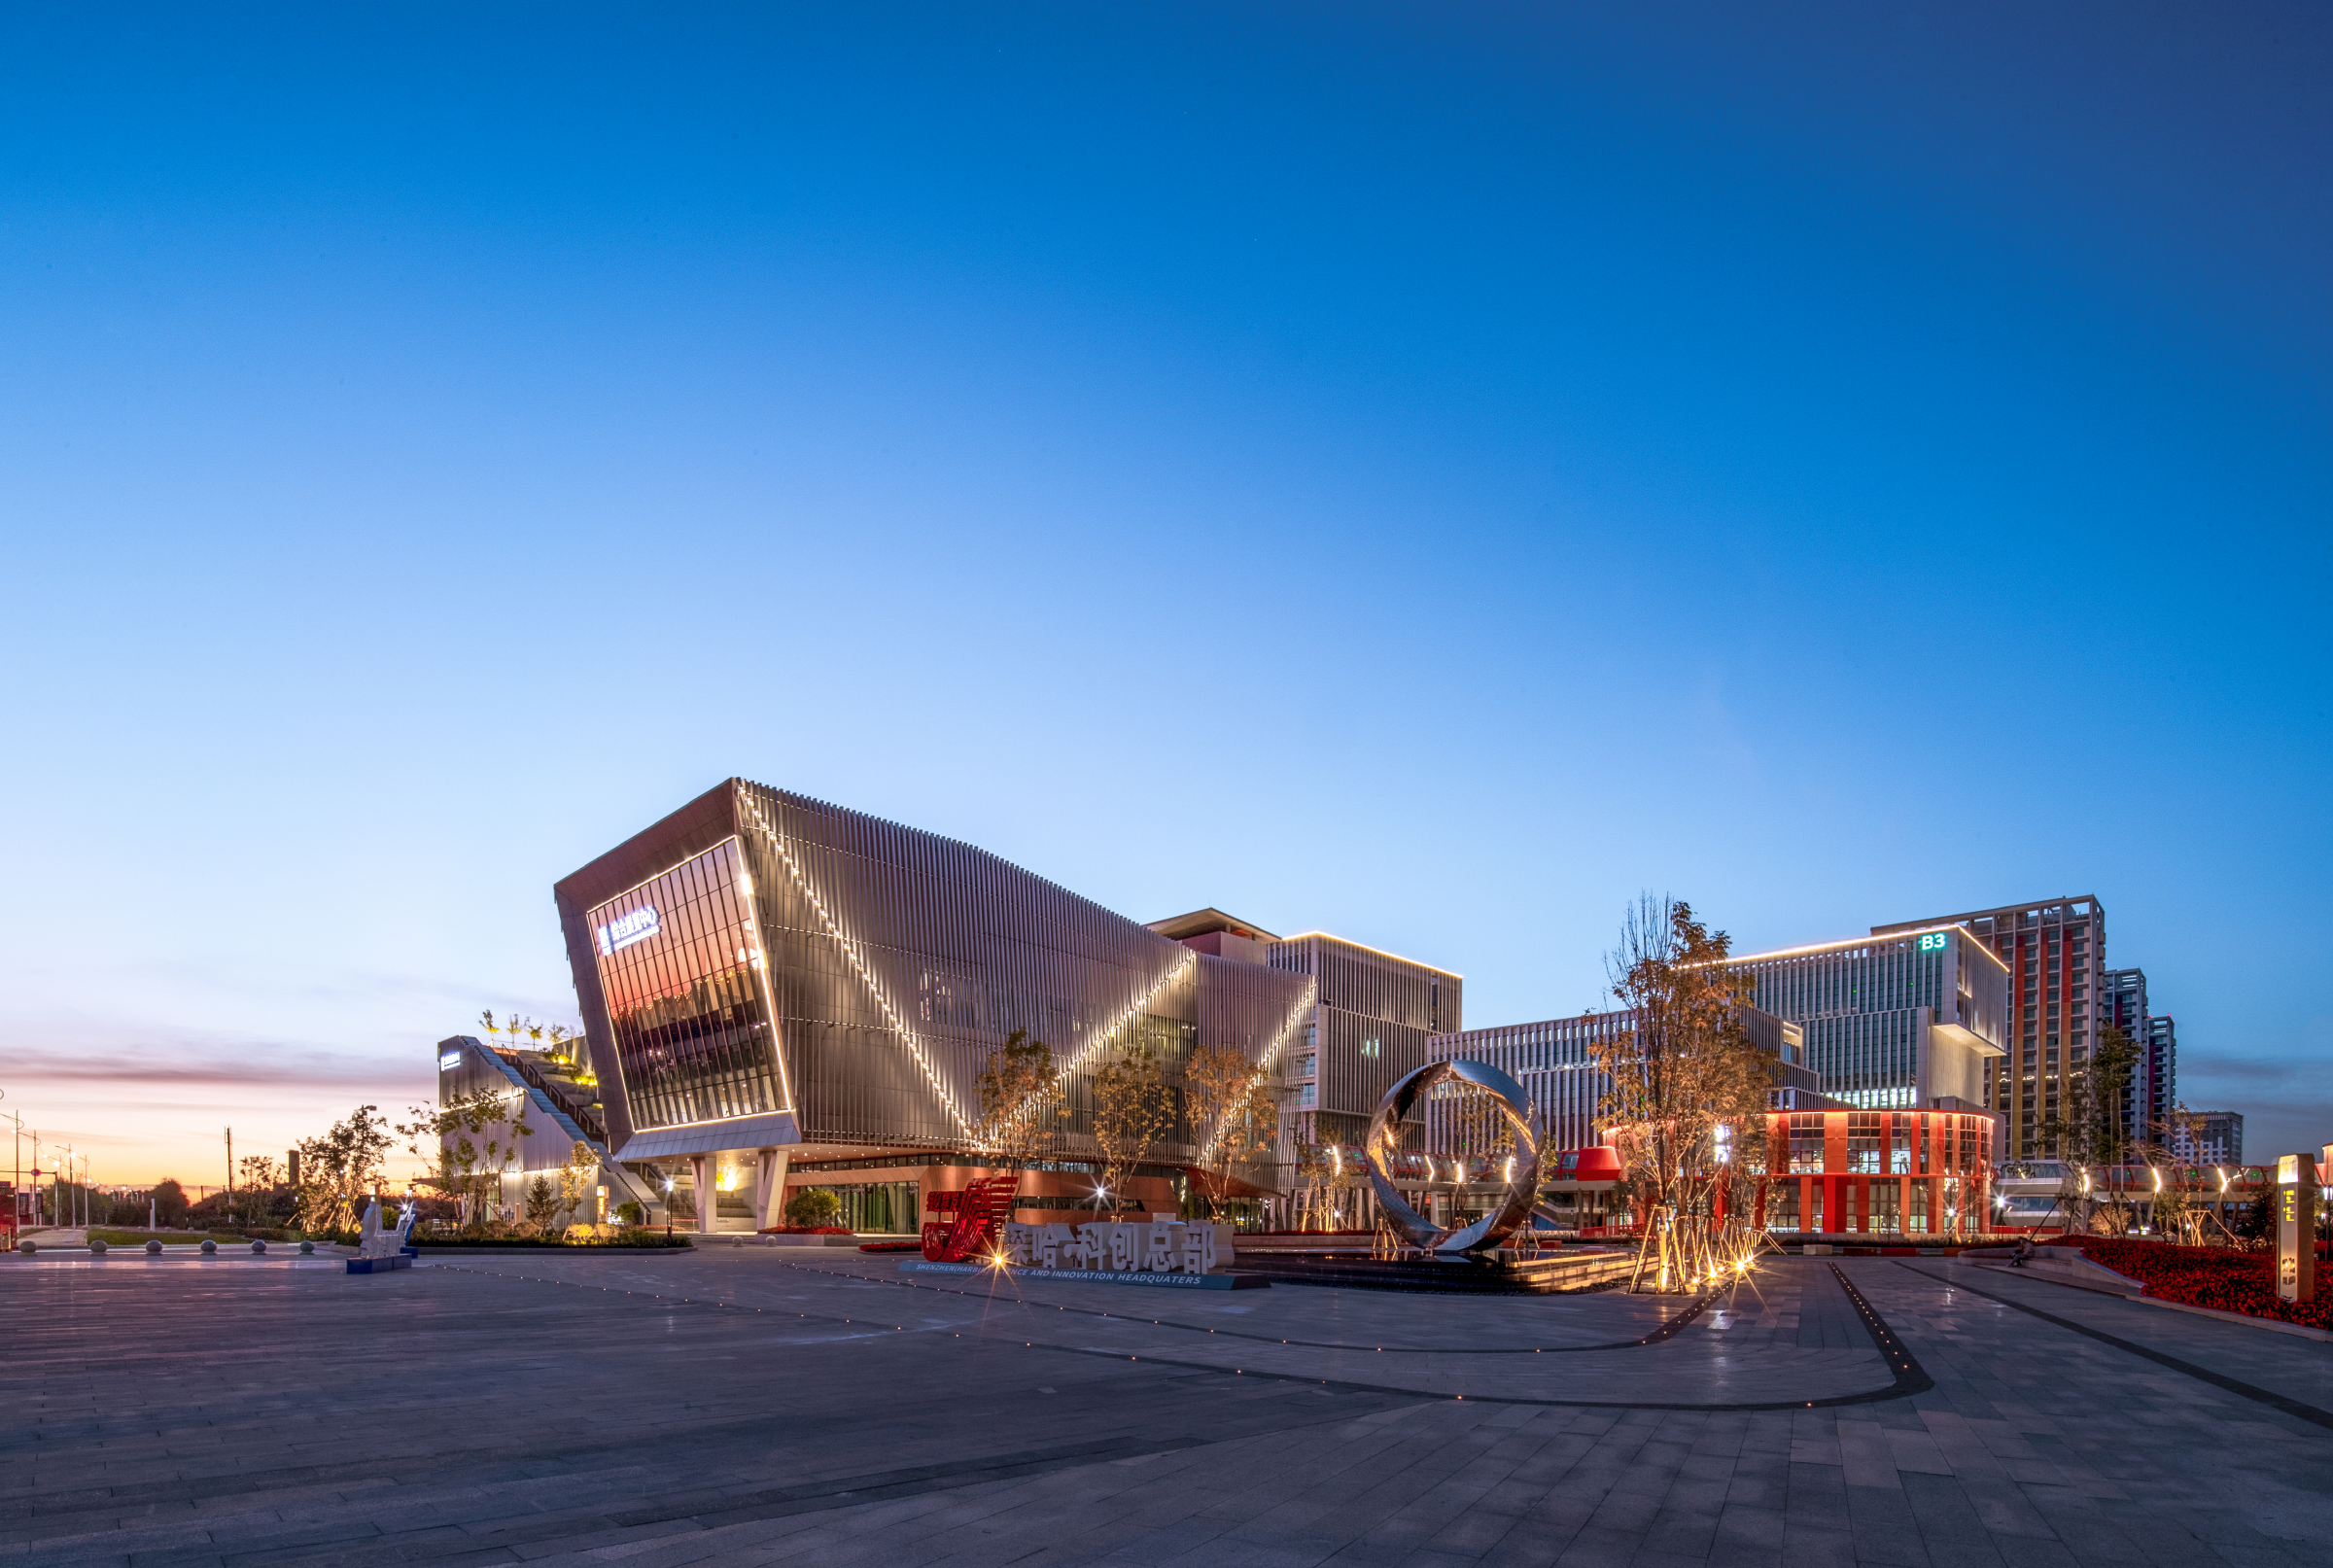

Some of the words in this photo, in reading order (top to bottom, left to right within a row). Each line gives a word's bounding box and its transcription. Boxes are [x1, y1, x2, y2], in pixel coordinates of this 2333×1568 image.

[1922, 932, 1945, 951] B3
[1052, 1270, 1115, 1280] INNOVATION
[1117, 1272, 1201, 1285] HEADQUATERS
